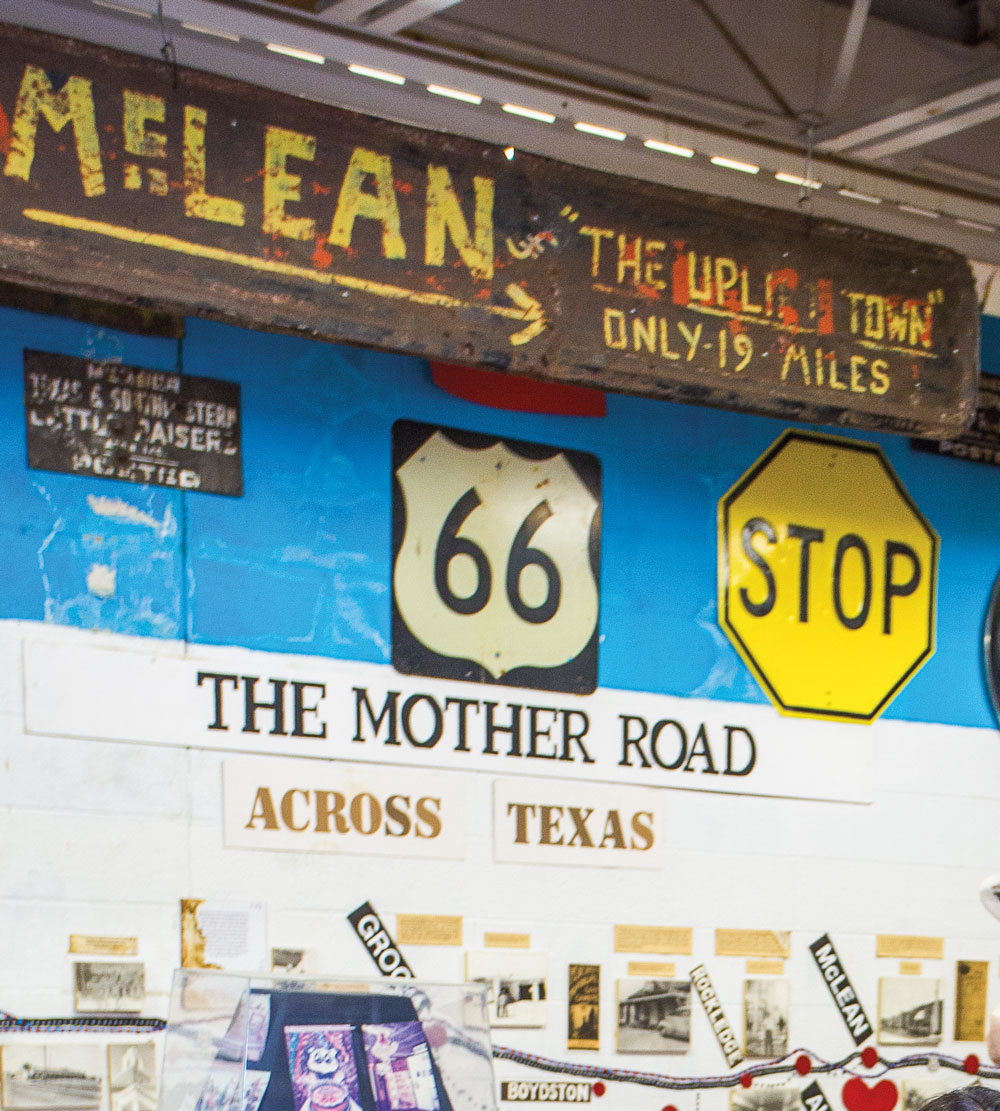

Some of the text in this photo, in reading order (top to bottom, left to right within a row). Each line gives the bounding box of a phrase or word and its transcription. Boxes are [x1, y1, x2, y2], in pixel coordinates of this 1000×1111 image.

[780, 343, 891, 396] MILES
[433, 486, 562, 624] 66
[739, 516, 922, 636] STOP
[197, 671, 759, 777] THE MOTHER ROAD
[244, 785, 655, 851] ACROSS TEXAS
[815, 942, 869, 1038] McLEAN
[507, 1081, 589, 1102] BOYDSTON
